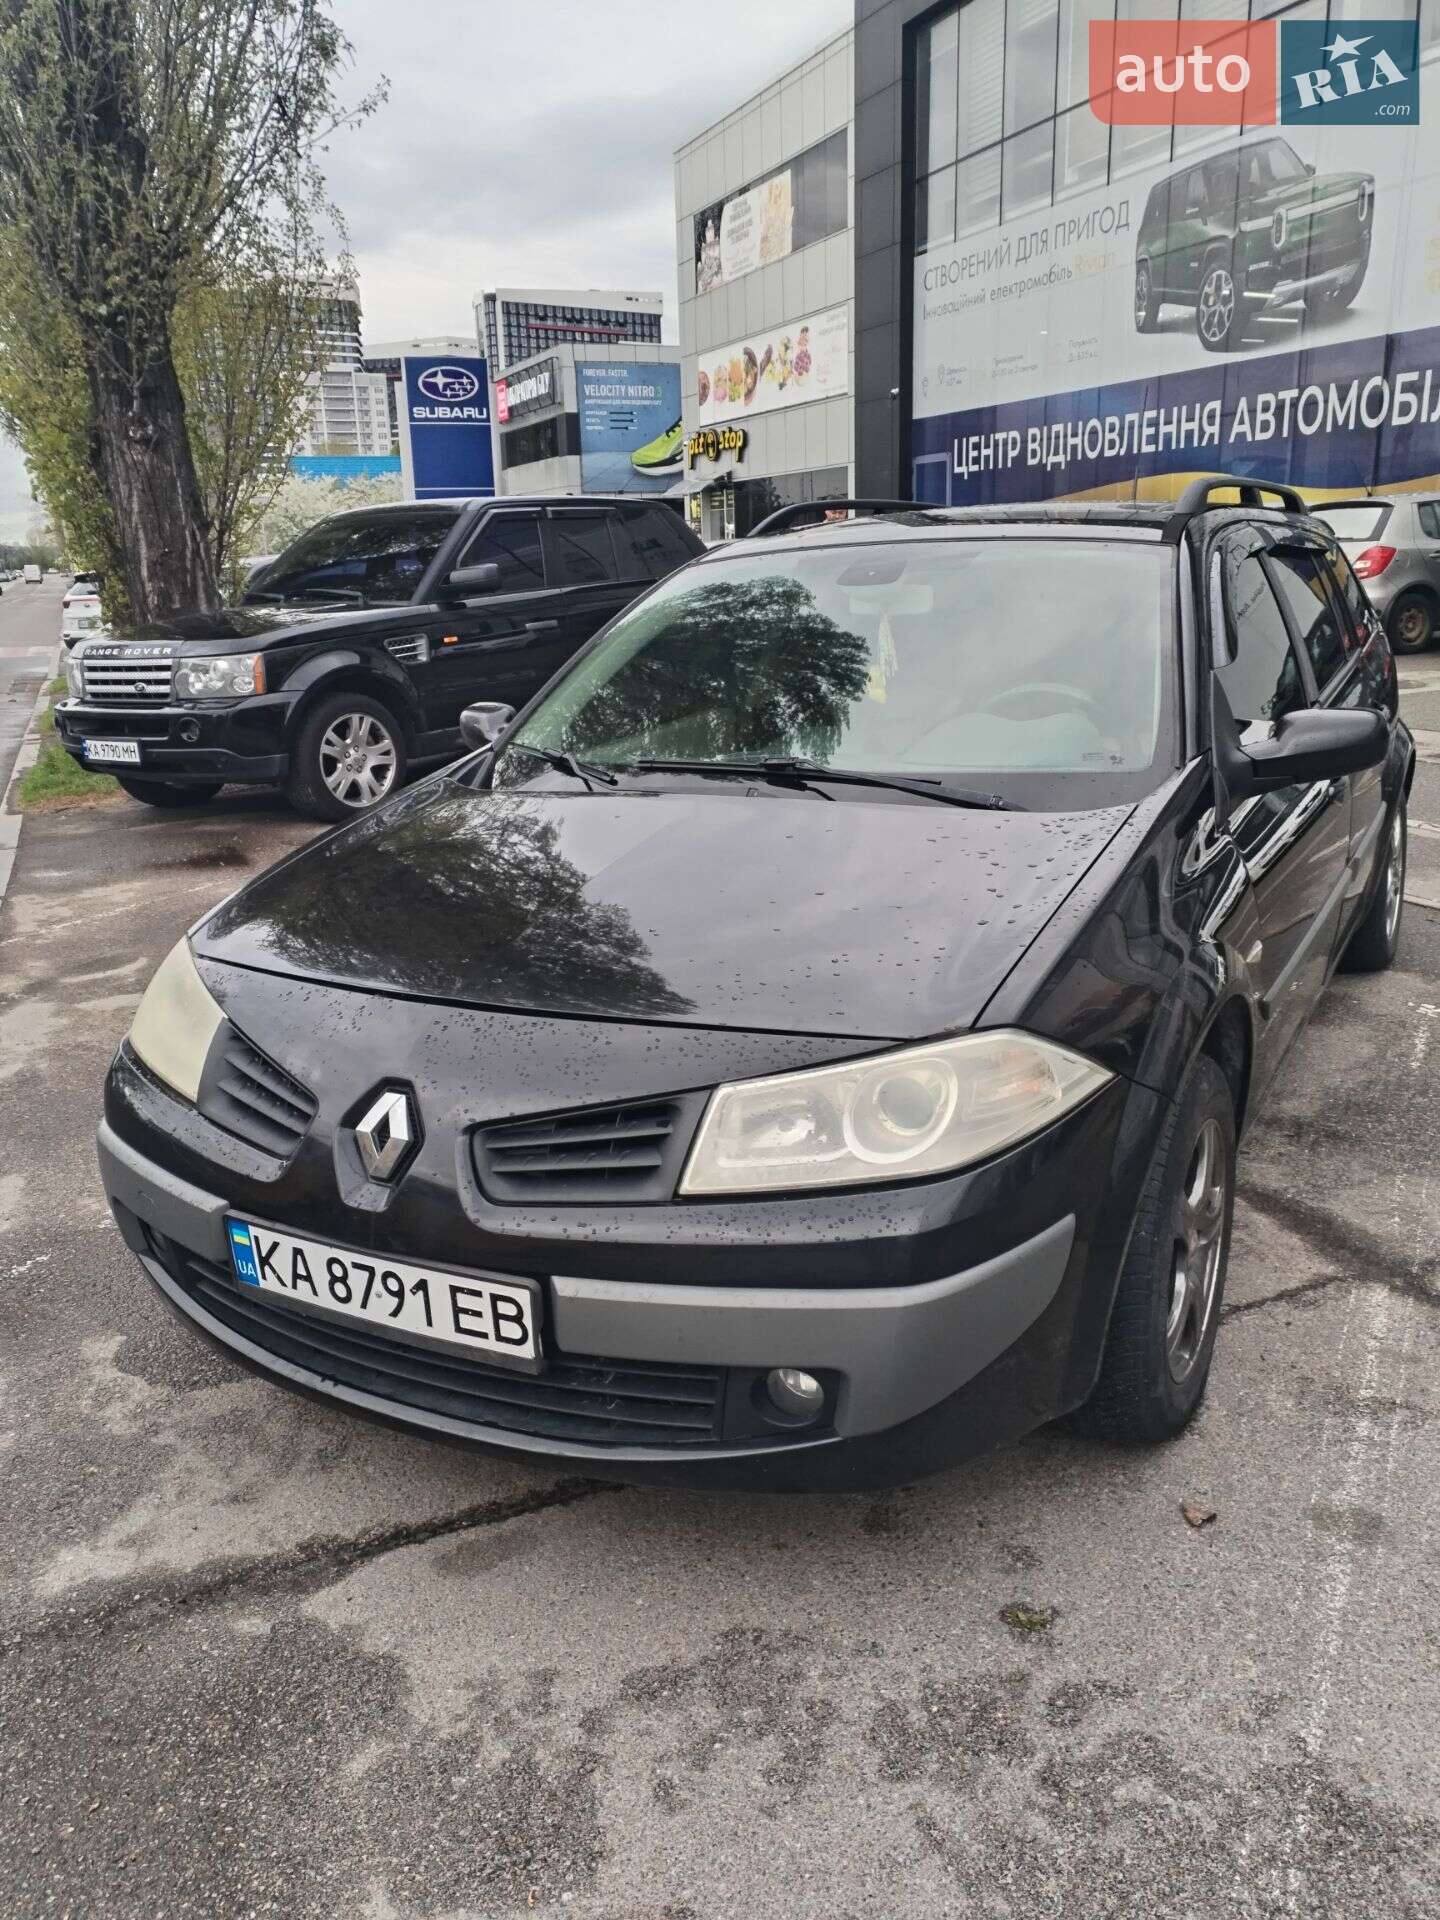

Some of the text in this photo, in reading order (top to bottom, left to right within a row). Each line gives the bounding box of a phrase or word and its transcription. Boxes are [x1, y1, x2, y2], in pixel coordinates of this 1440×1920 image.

[923, 200, 1130, 292] СТВОРЕНИЙ ДЛЯ ПРИГОД
[989, 264, 1073, 300] електромобіль
[584, 384, 626, 397] VELOCITY
[627, 385, 655, 397] NITRO
[412, 406, 487, 419] SUBARU
[718, 427, 746, 463] stop
[952, 430, 1022, 480] ЦЕНТР
[1026, 399, 1222, 471] ВІДНОВЛЕННЯ
[82, 647, 172, 656] RANGE ROVER
[101, 743, 121, 758] 9790
[121, 745, 137, 760] MH
[238, 1259, 257, 1277] UA
[253, 1235, 530, 1346] KA 8791 EB
